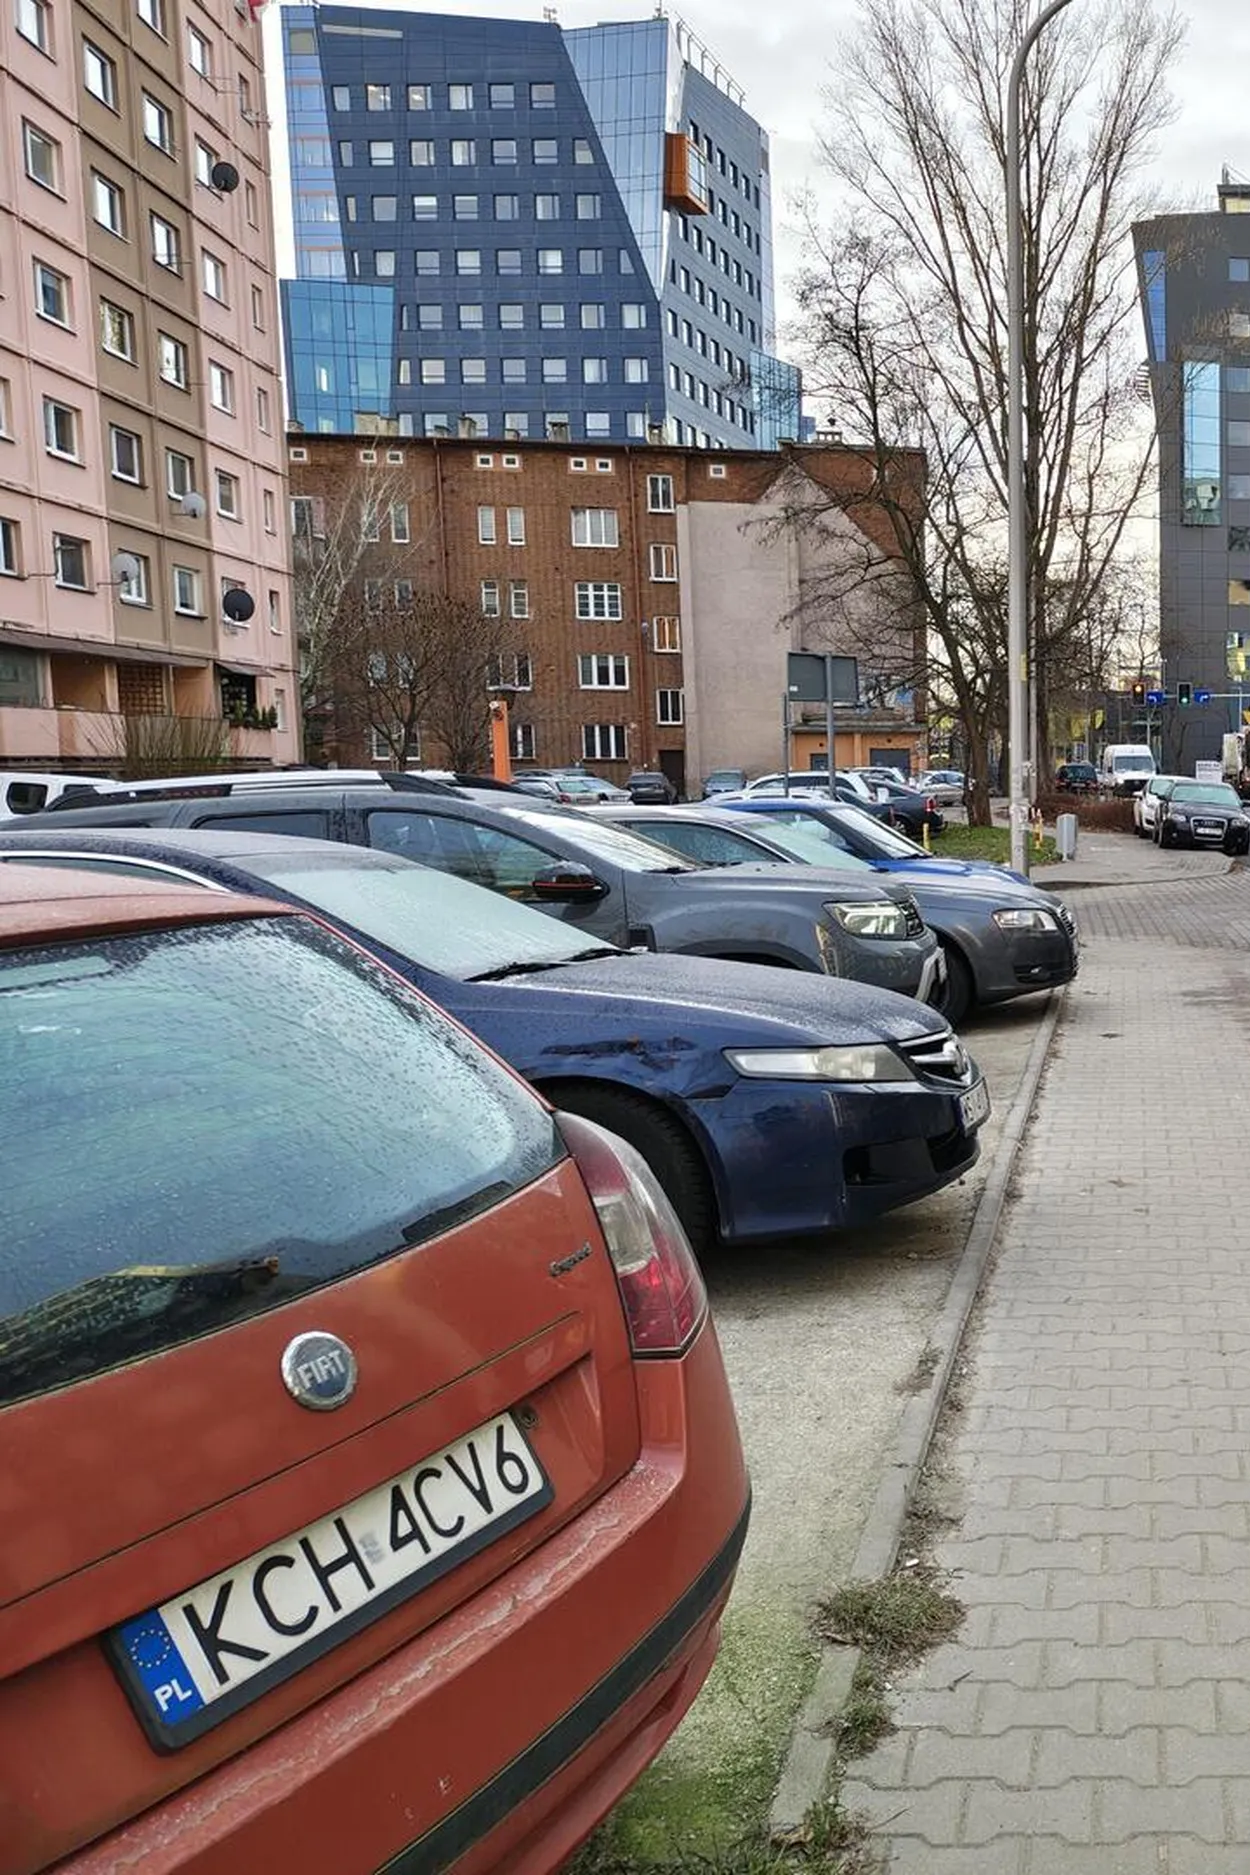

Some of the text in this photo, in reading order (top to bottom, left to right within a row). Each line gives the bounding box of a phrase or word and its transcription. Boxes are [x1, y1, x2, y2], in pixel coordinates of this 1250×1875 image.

[297, 1350, 345, 1389] FIAT
[182, 1424, 529, 1686] KCH 4CV6
[154, 1678, 193, 1712] PL
